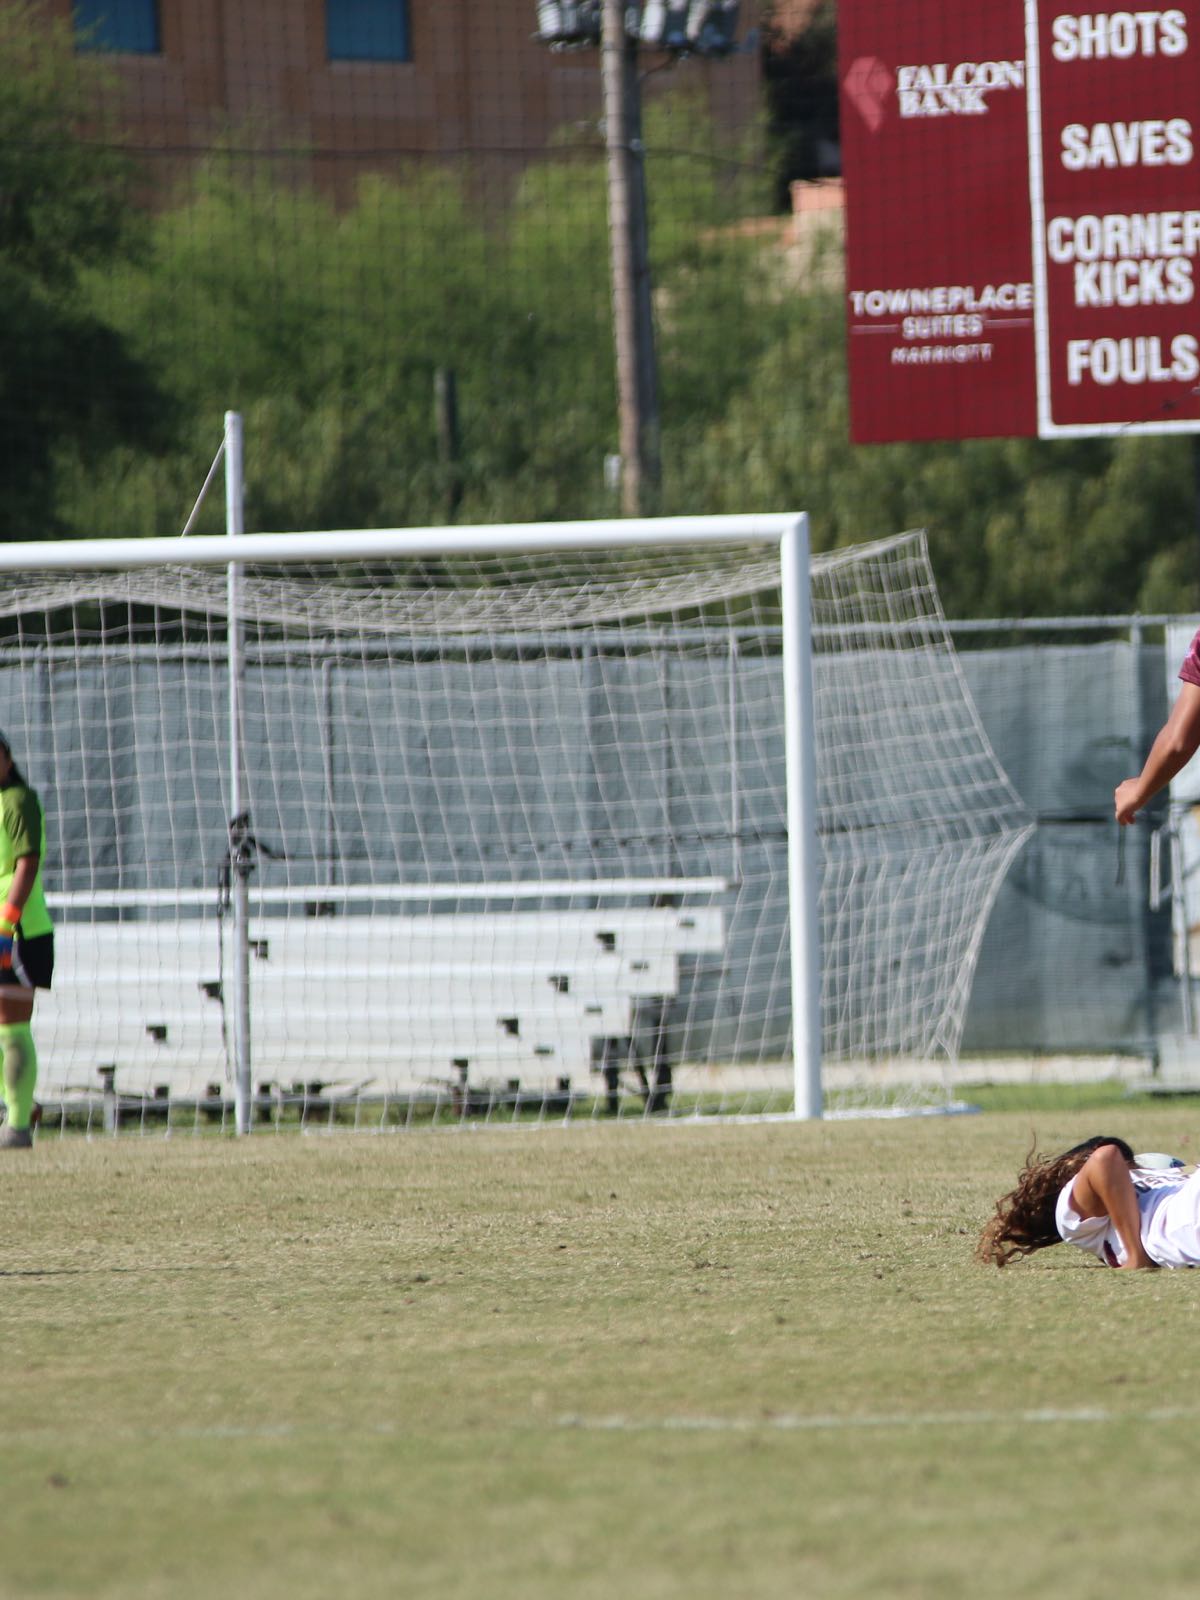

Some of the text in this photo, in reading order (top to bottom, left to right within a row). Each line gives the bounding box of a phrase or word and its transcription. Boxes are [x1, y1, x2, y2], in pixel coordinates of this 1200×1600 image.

[1052, 9, 1189, 62] SHOTS
[897, 60, 1024, 90] FALCON
[897, 87, 989, 117] BANK
[1060, 119, 1193, 170] SAVES
[1074, 257, 1194, 307] KICKS
[850, 283, 1033, 316] TOWNEPLACE
[902, 314, 983, 339] SUITES
[891, 343, 993, 364] MARRIOTT
[1067, 334, 1199, 385] FOULS
